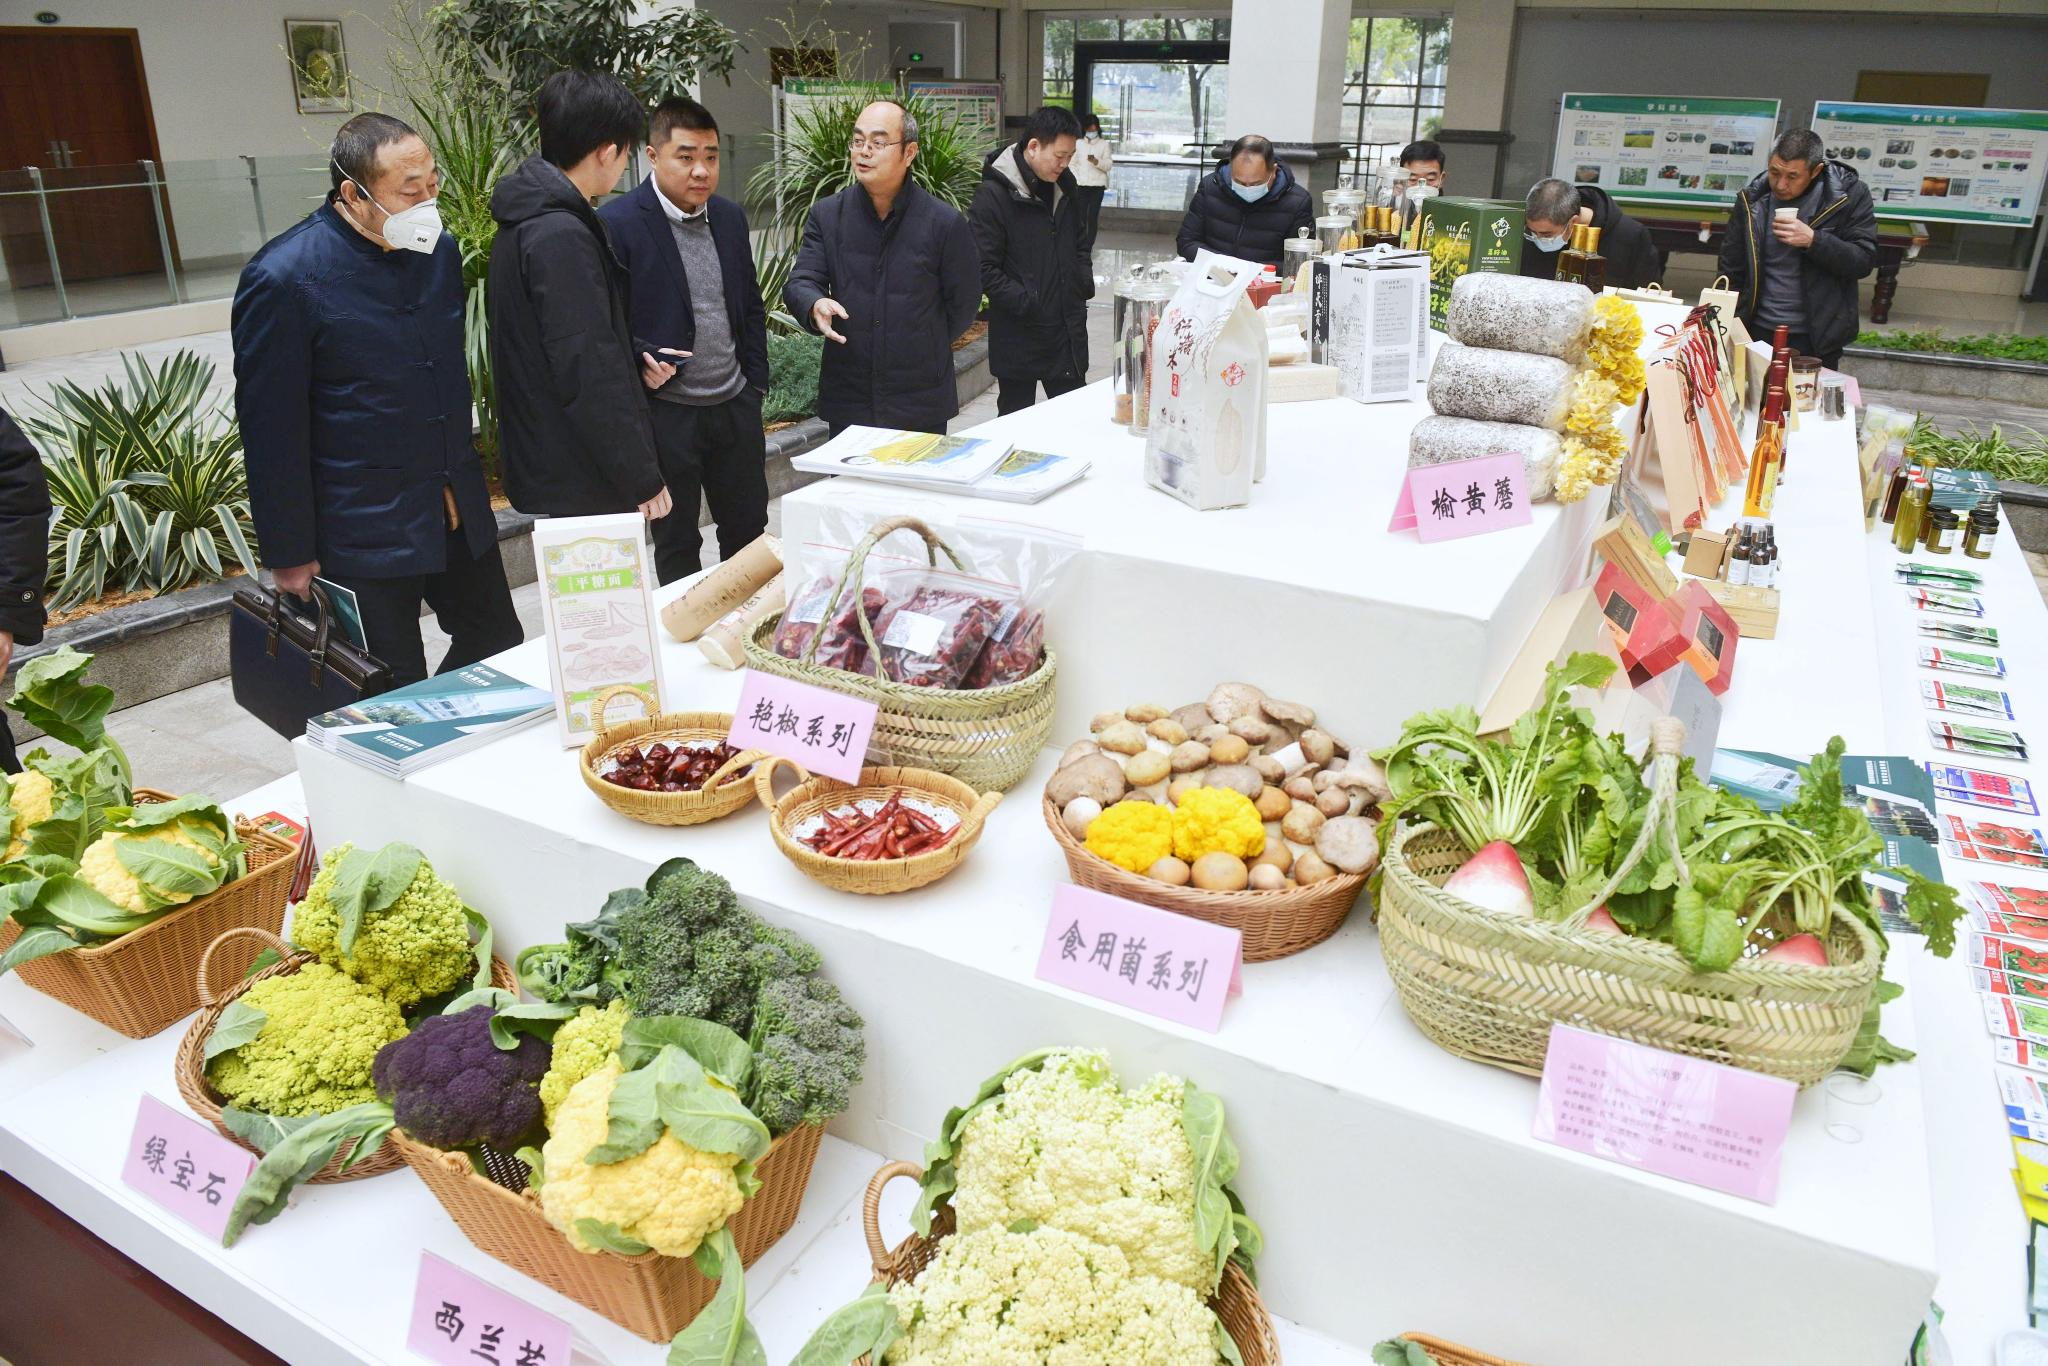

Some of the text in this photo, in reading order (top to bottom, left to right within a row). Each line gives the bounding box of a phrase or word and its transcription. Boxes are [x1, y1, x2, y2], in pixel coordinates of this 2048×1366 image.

[1431, 476, 1514, 521] 榆黄蘑
[748, 697, 856, 758] 艳椒系列
[1058, 919, 1209, 1003] 食用菌系列
[141, 1135, 226, 1207] 绿宝石
